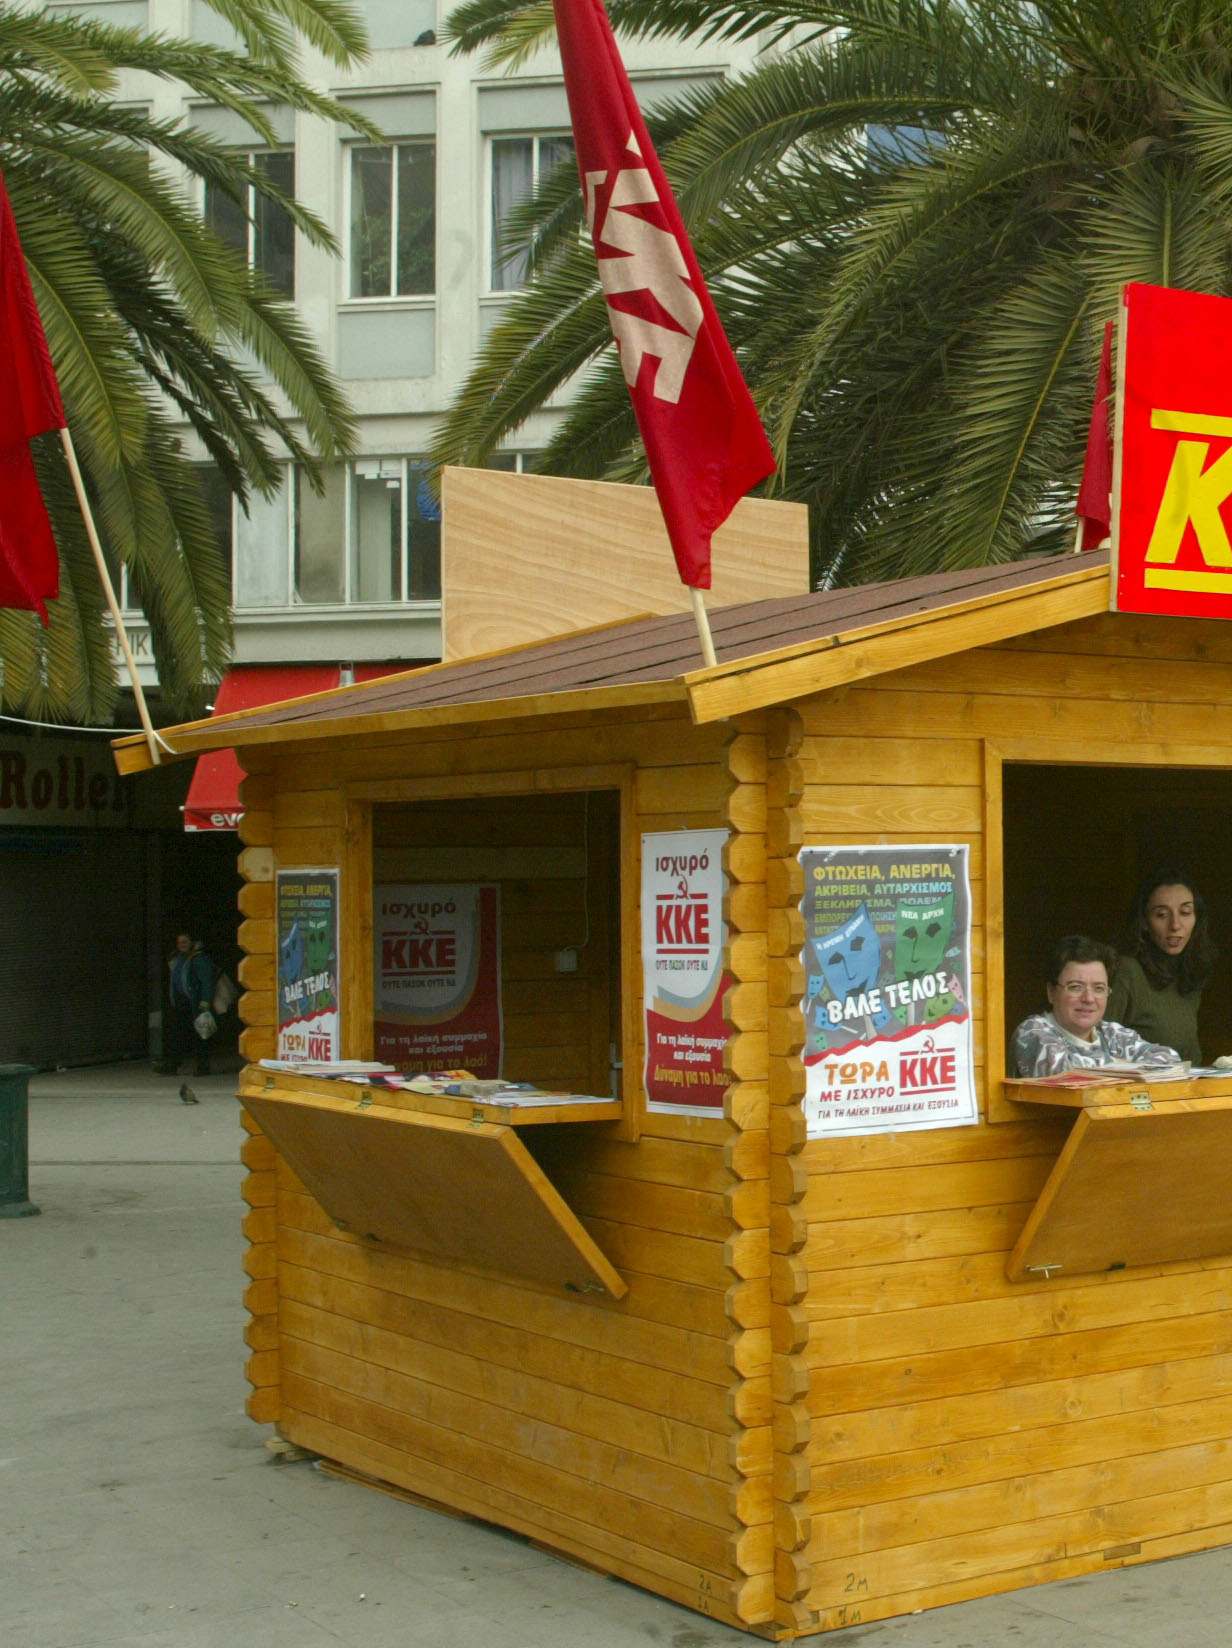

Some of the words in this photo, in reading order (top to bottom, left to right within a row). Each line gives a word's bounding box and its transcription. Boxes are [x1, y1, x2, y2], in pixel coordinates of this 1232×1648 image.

[655, 847, 710, 877] ισχυρό
[813, 864, 885, 881] ΦΤΩΧΕΙΑ,
[889, 863, 956, 879] ΑΝΕΡΓΙΑ,
[814, 884, 871, 897] ΑΚΡΙΒΕΙΑ,
[381, 898, 457, 920] ισχυρό
[656, 903, 710, 945] ΚΚΕ
[382, 938, 456, 970] ΚΚΕ
[826, 989, 882, 1024] ΒΑΛΕ
[884, 971, 950, 1008] ΤΕΛΟΣ
[308, 1036, 331, 1062] ΚΚΕ
[824, 1060, 890, 1086] ΤΩΡΑ
[900, 1055, 956, 1088] ΚΚΕ
[820, 1090, 842, 1102] ΜΕ
[846, 1086, 895, 1101] ΙΣΧΥΡΟ
[818, 1110, 831, 1119] ΓΙΑ
[834, 1108, 844, 1117] ΤΗ
